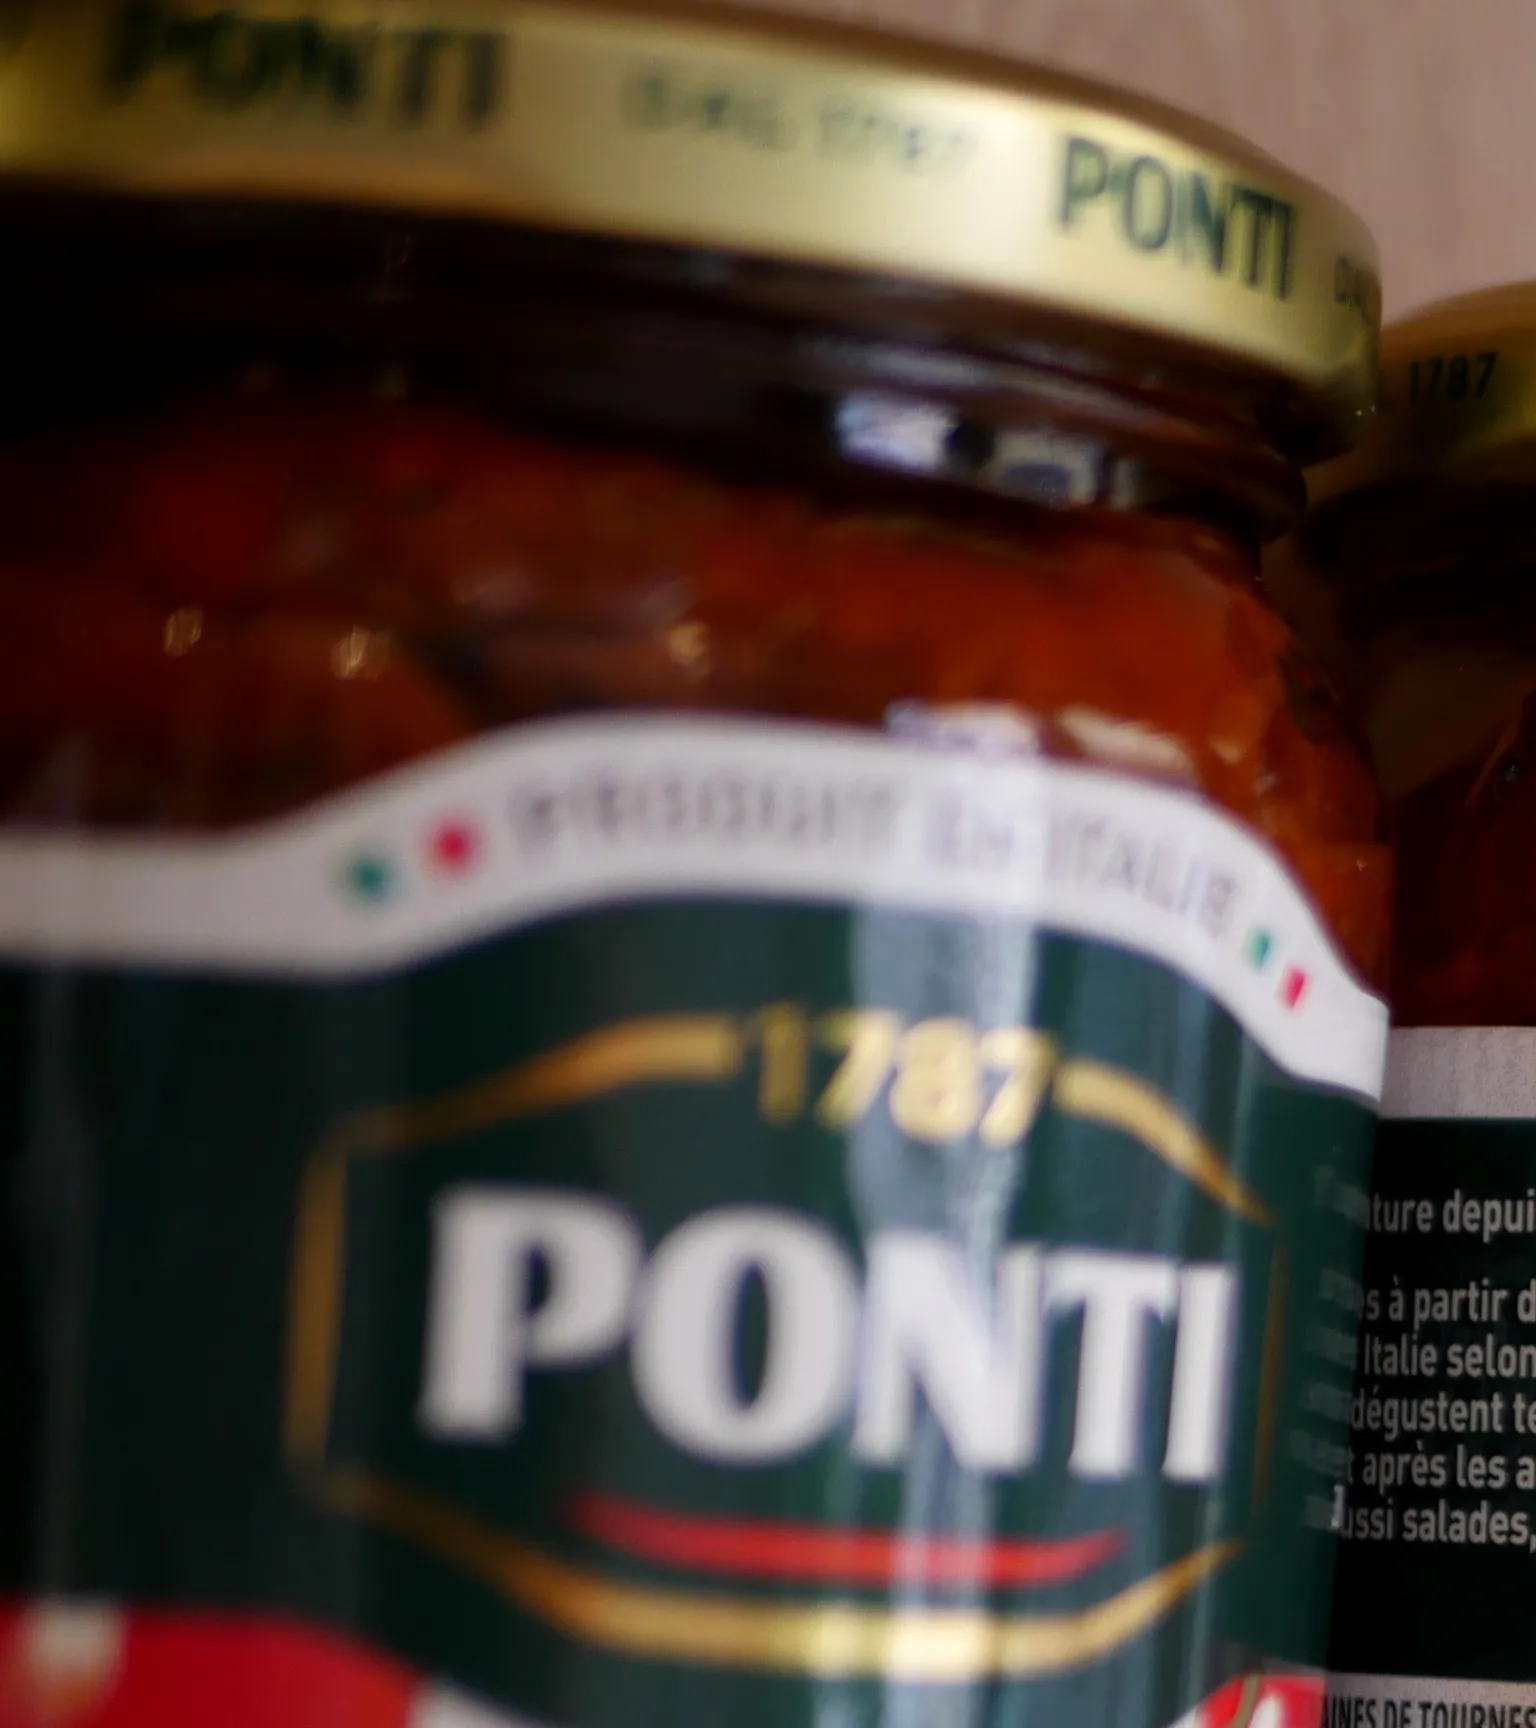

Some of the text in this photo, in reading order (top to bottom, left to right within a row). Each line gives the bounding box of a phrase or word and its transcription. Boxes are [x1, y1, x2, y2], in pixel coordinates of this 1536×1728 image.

[1058, 136, 1298, 301] PONTI
[752, 1003, 1054, 1146] 1787
[1365, 1190, 1433, 1234] ture
[1388, 1273, 1404, 1322] à
[1413, 1279, 1509, 1333] partir
[415, 1183, 1238, 1484] PONTI
[1350, 1384, 1504, 1442] dégustent
[1362, 1439, 1446, 1497] après
[1455, 1446, 1508, 1490] les
